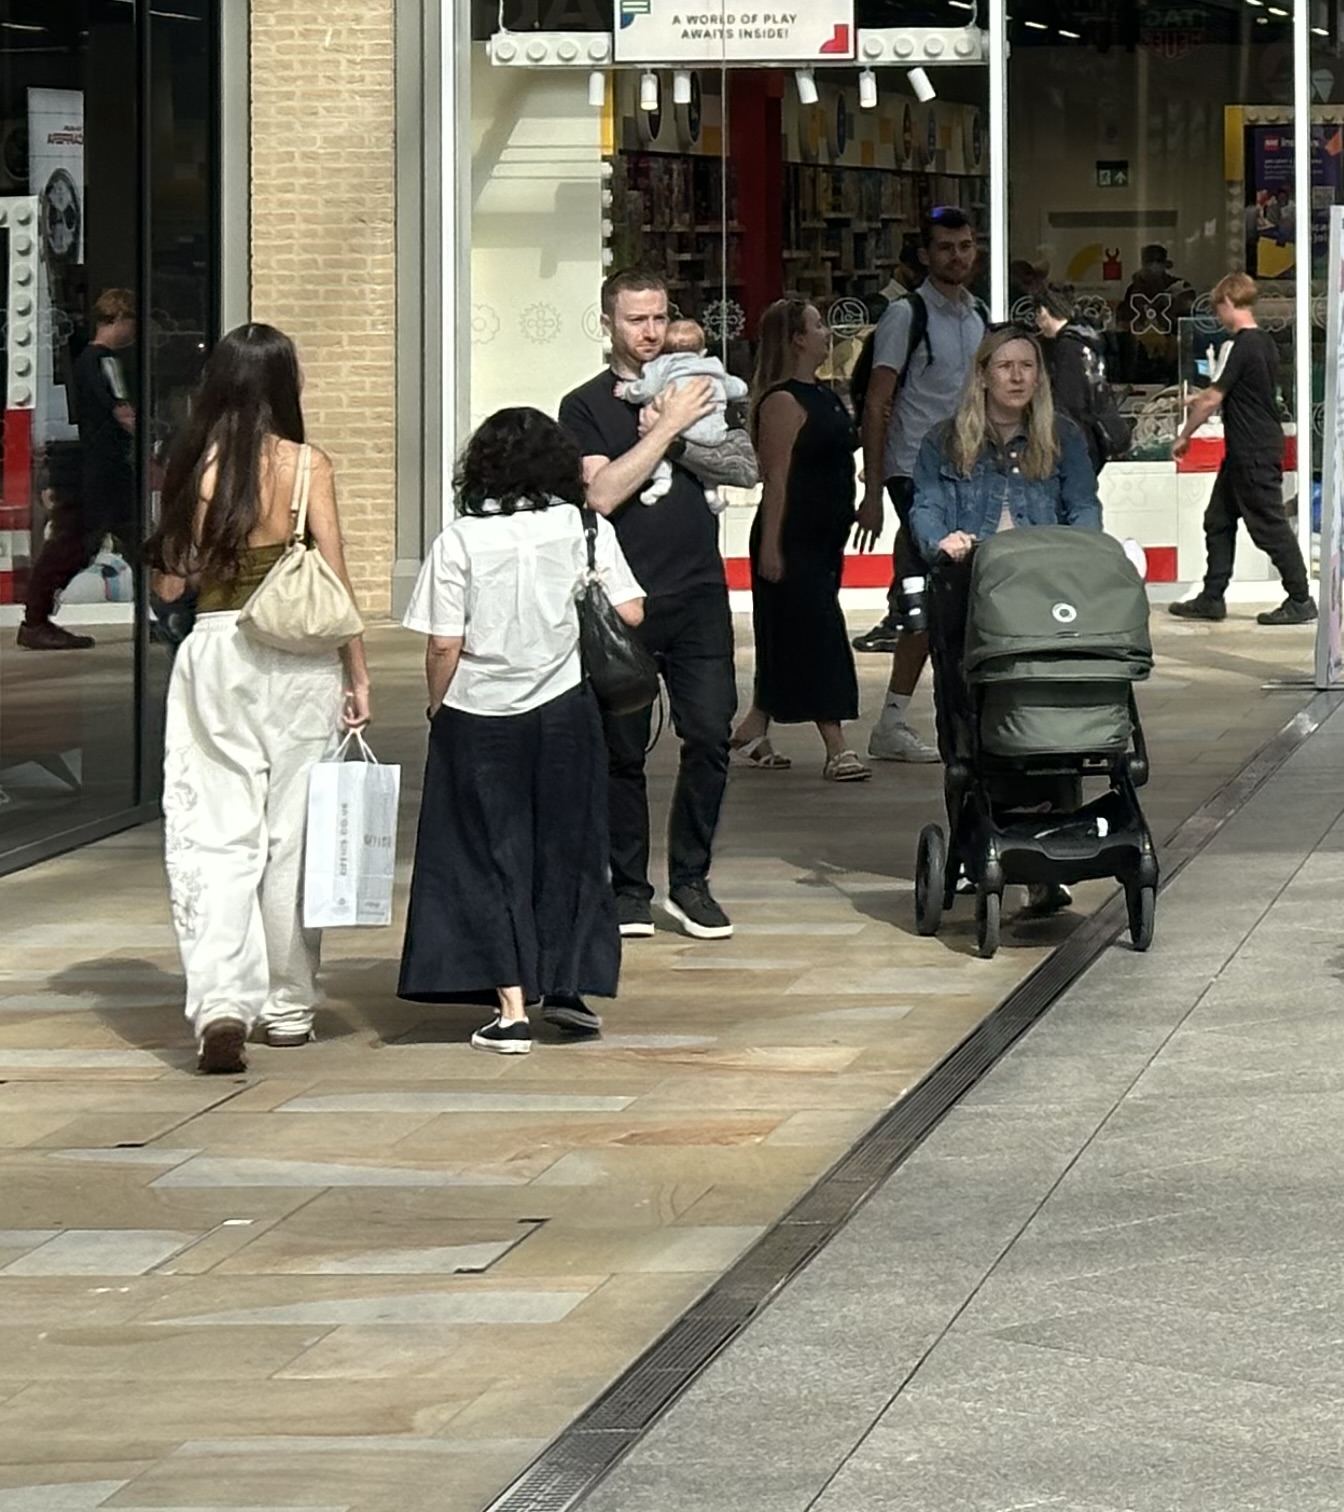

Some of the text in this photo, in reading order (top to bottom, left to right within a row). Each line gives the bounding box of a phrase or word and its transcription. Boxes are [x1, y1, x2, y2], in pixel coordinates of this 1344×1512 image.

[672, 14, 797, 25] A WORLD OF PLAY
[681, 29, 789, 39] AWAITS INSIDE!
